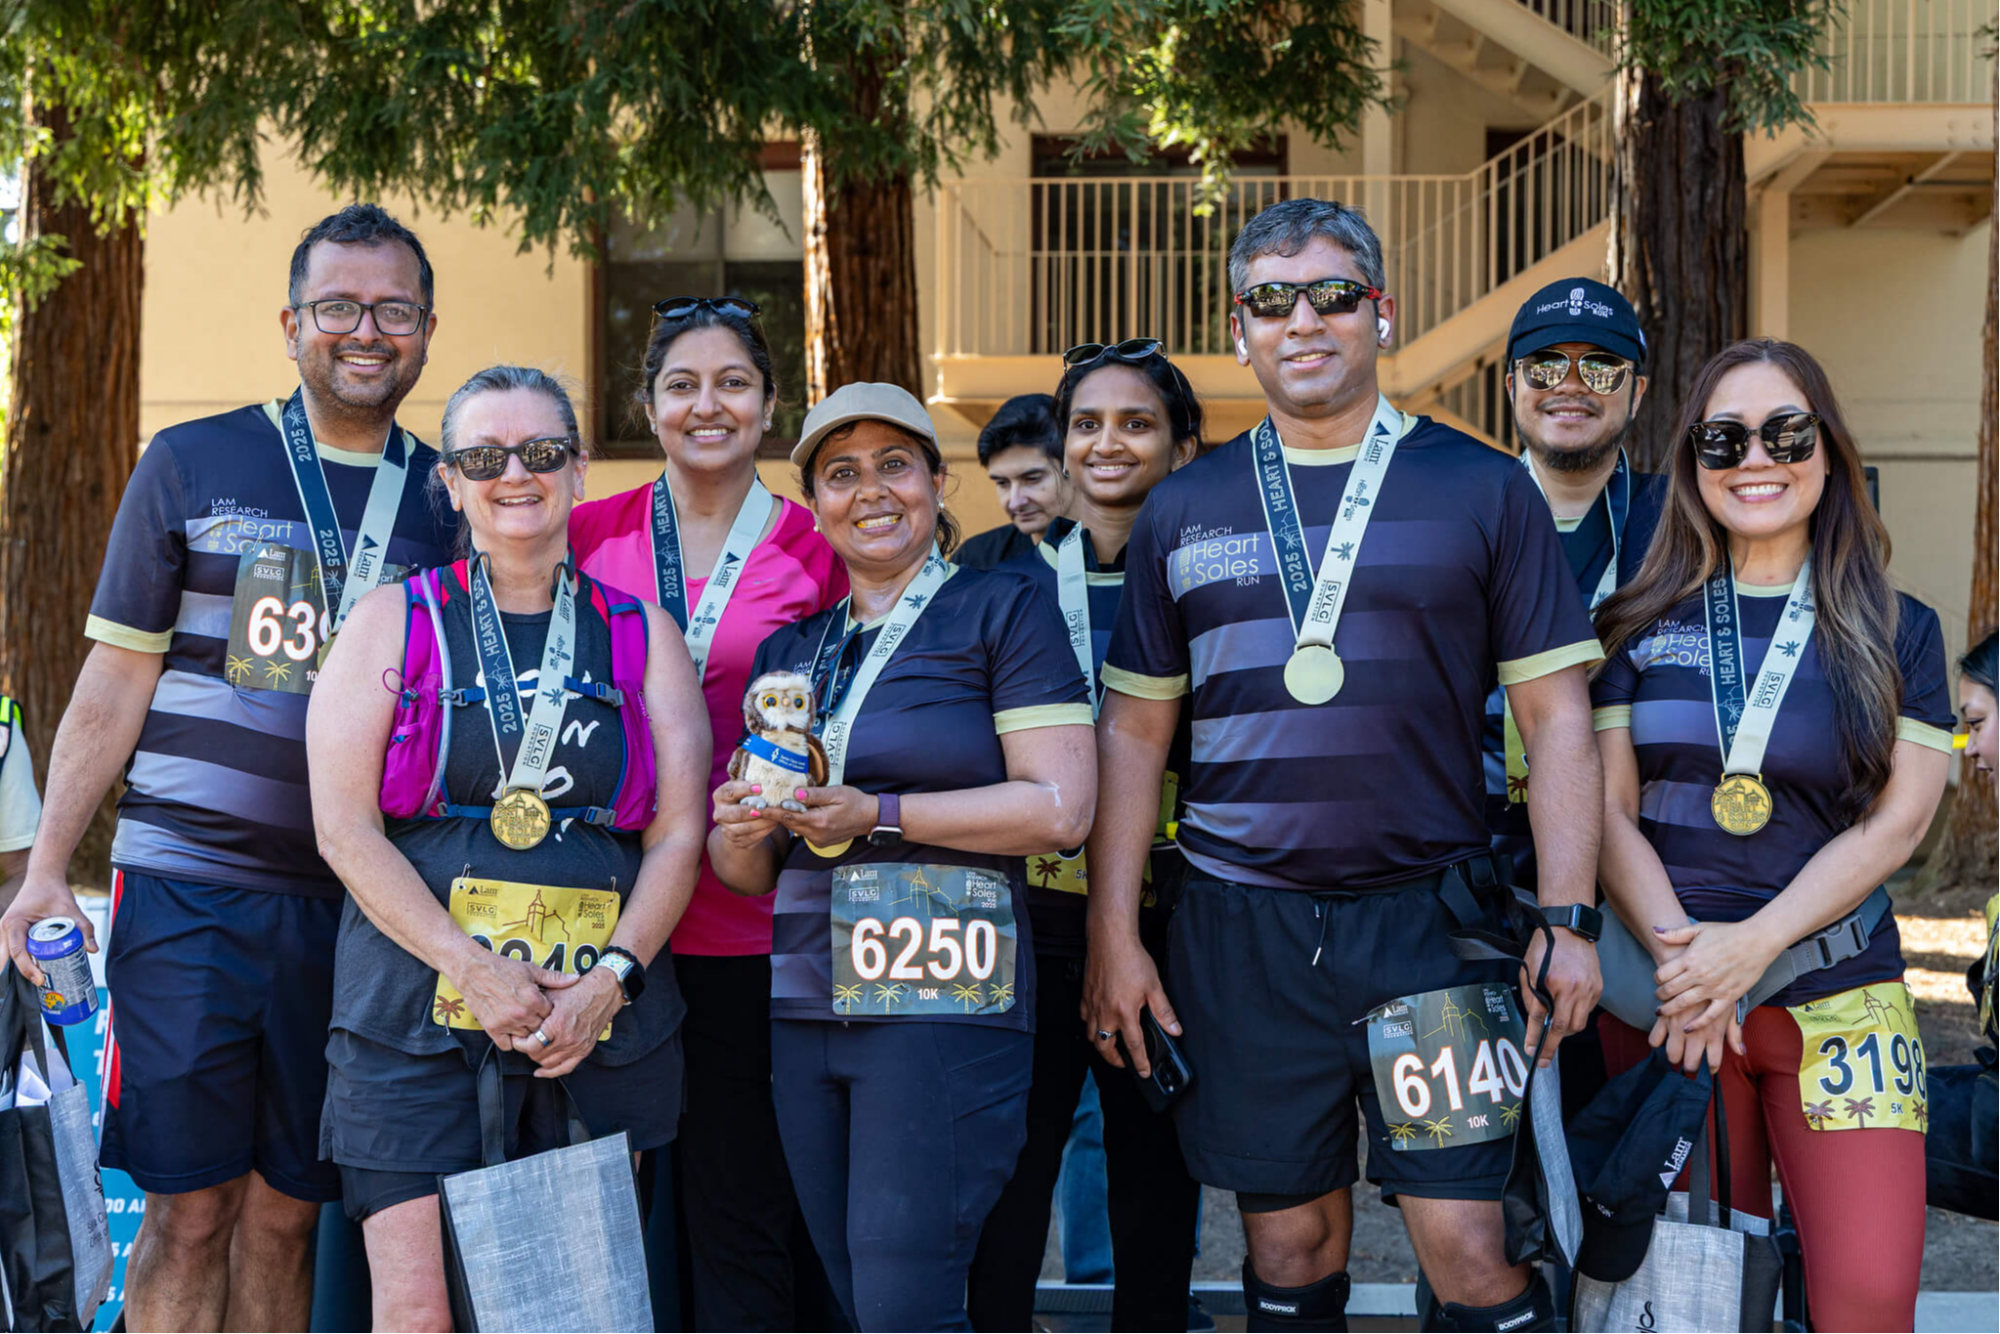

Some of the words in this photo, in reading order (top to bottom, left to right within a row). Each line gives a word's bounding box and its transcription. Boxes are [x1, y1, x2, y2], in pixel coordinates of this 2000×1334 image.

[1536, 299, 1570, 315] Heart
[1583, 300, 1614, 316] Soles
[291, 429, 312, 461] 2025
[1259, 419, 1273, 450] SOL
[1368, 438, 1389, 465] Lam
[1264, 464, 1288, 512] HEART
[211, 498, 236, 507] LAM
[211, 505, 268, 518] RESEARCH
[654, 494, 671, 535] HEART
[226, 514, 294, 539] Heart
[1180, 523, 1201, 537] LAM
[1180, 527, 1233, 547] RESEARCH
[320, 529, 340, 567] 2025
[1192, 533, 1260, 563] Heart
[358, 552, 377, 580] Lam
[1194, 557, 1259, 585] Soles
[1285, 553, 1307, 592] 2025
[663, 567, 679, 598] 2025
[1236, 576, 1260, 587] RUN
[1319, 584, 1337, 621] SVLG
[1713, 577, 1731, 623] SOLES
[479, 613, 500, 657] HEART
[1658, 618, 1680, 628] LAM
[1665, 647, 1711, 667] Sole
[1718, 640, 1737, 685] HEART
[306, 670, 318, 681] 10
[1699, 667, 1711, 677] RU
[1761, 674, 1780, 706] SVLG
[496, 692, 517, 733] 2025
[530, 728, 549, 765] SVLG
[860, 869, 878, 878] Lam
[972, 879, 997, 890] Heart
[480, 886, 498, 896] Lam
[851, 889, 876, 897] SVLG
[971, 888, 997, 899] Soles
[470, 904, 495, 914] SVLG
[851, 916, 997, 981] 6250
[917, 988, 939, 1000] 10K
[1386, 1022, 1410, 1034] SVLG
[1392, 1038, 1529, 1118] 6140
[1818, 1032, 1926, 1102] 3198
[1467, 1114, 1490, 1129] 10K
[1890, 1102, 1904, 1114] 5K
[1664, 1136, 1686, 1169] Lam
